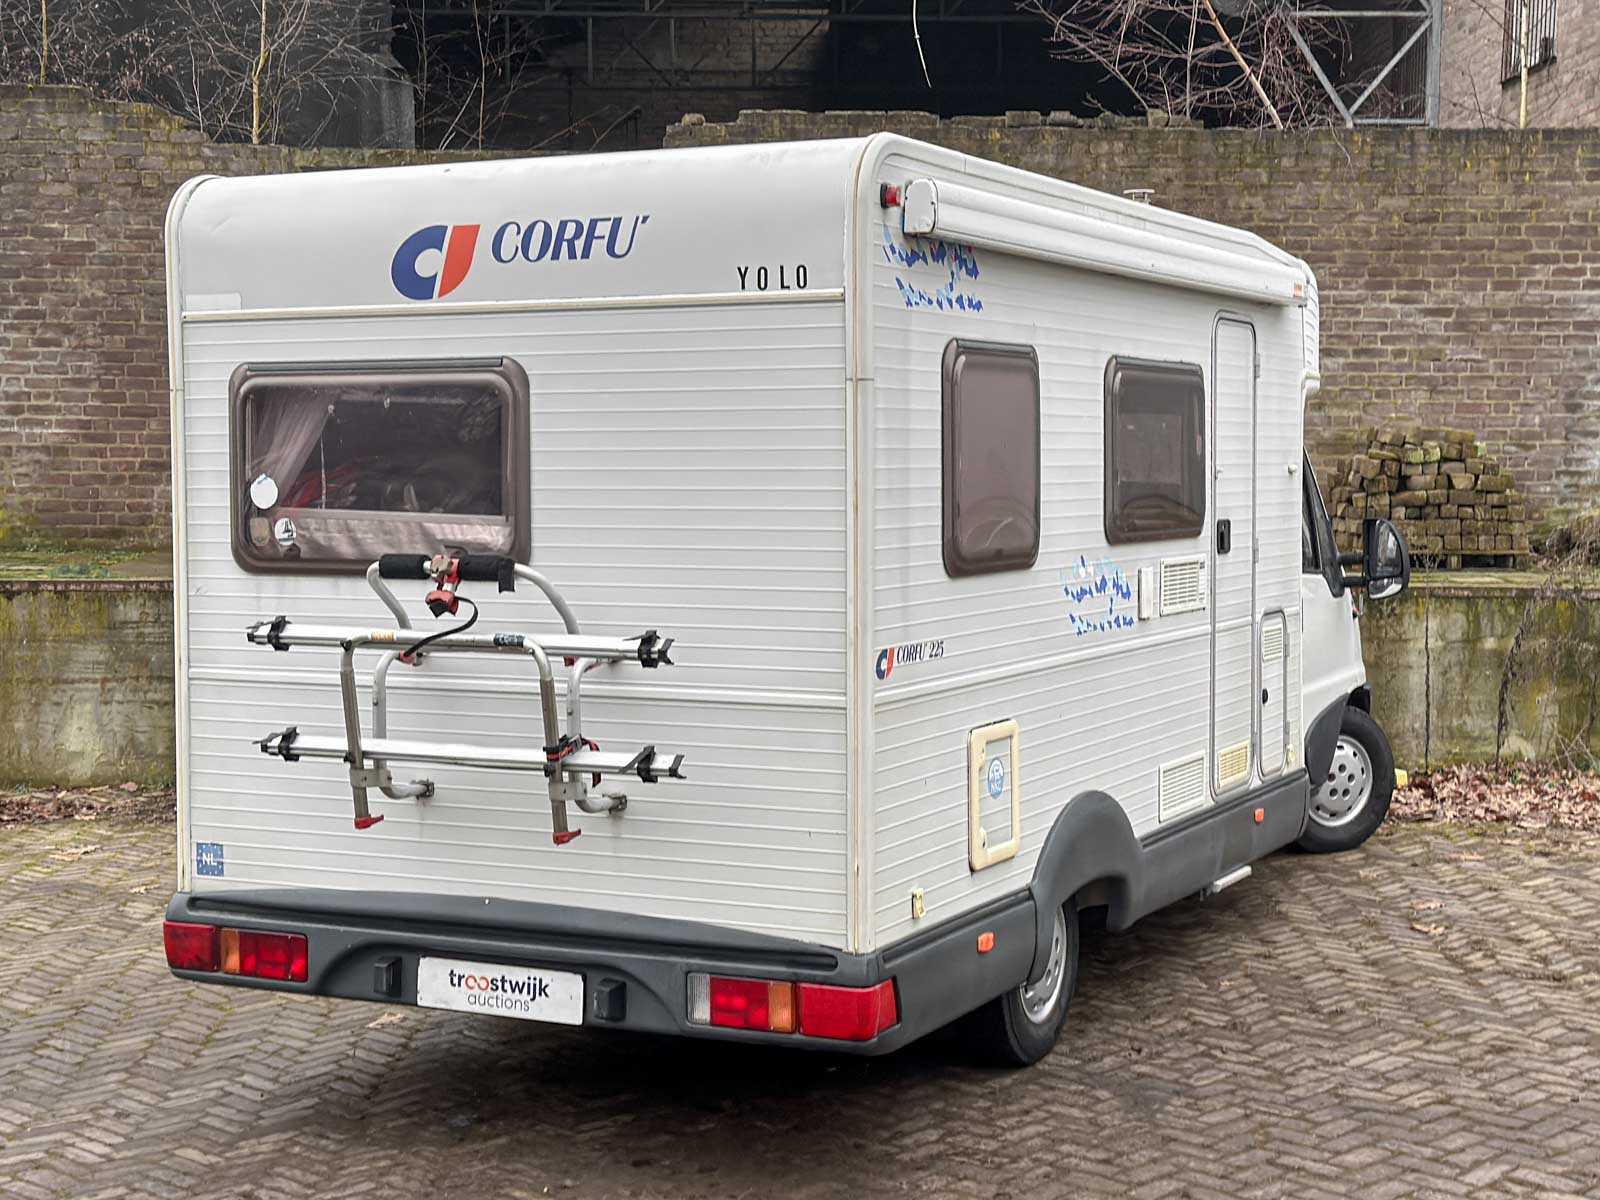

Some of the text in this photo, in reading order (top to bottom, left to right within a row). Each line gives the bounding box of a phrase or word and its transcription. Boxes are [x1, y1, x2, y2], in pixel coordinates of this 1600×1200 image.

[737, 264, 808, 291] YOLO
[929, 640, 944, 658] 225
[202, 853, 217, 865] NL
[449, 969, 549, 1001] troostwijk
[467, 993, 530, 1012] auctions
